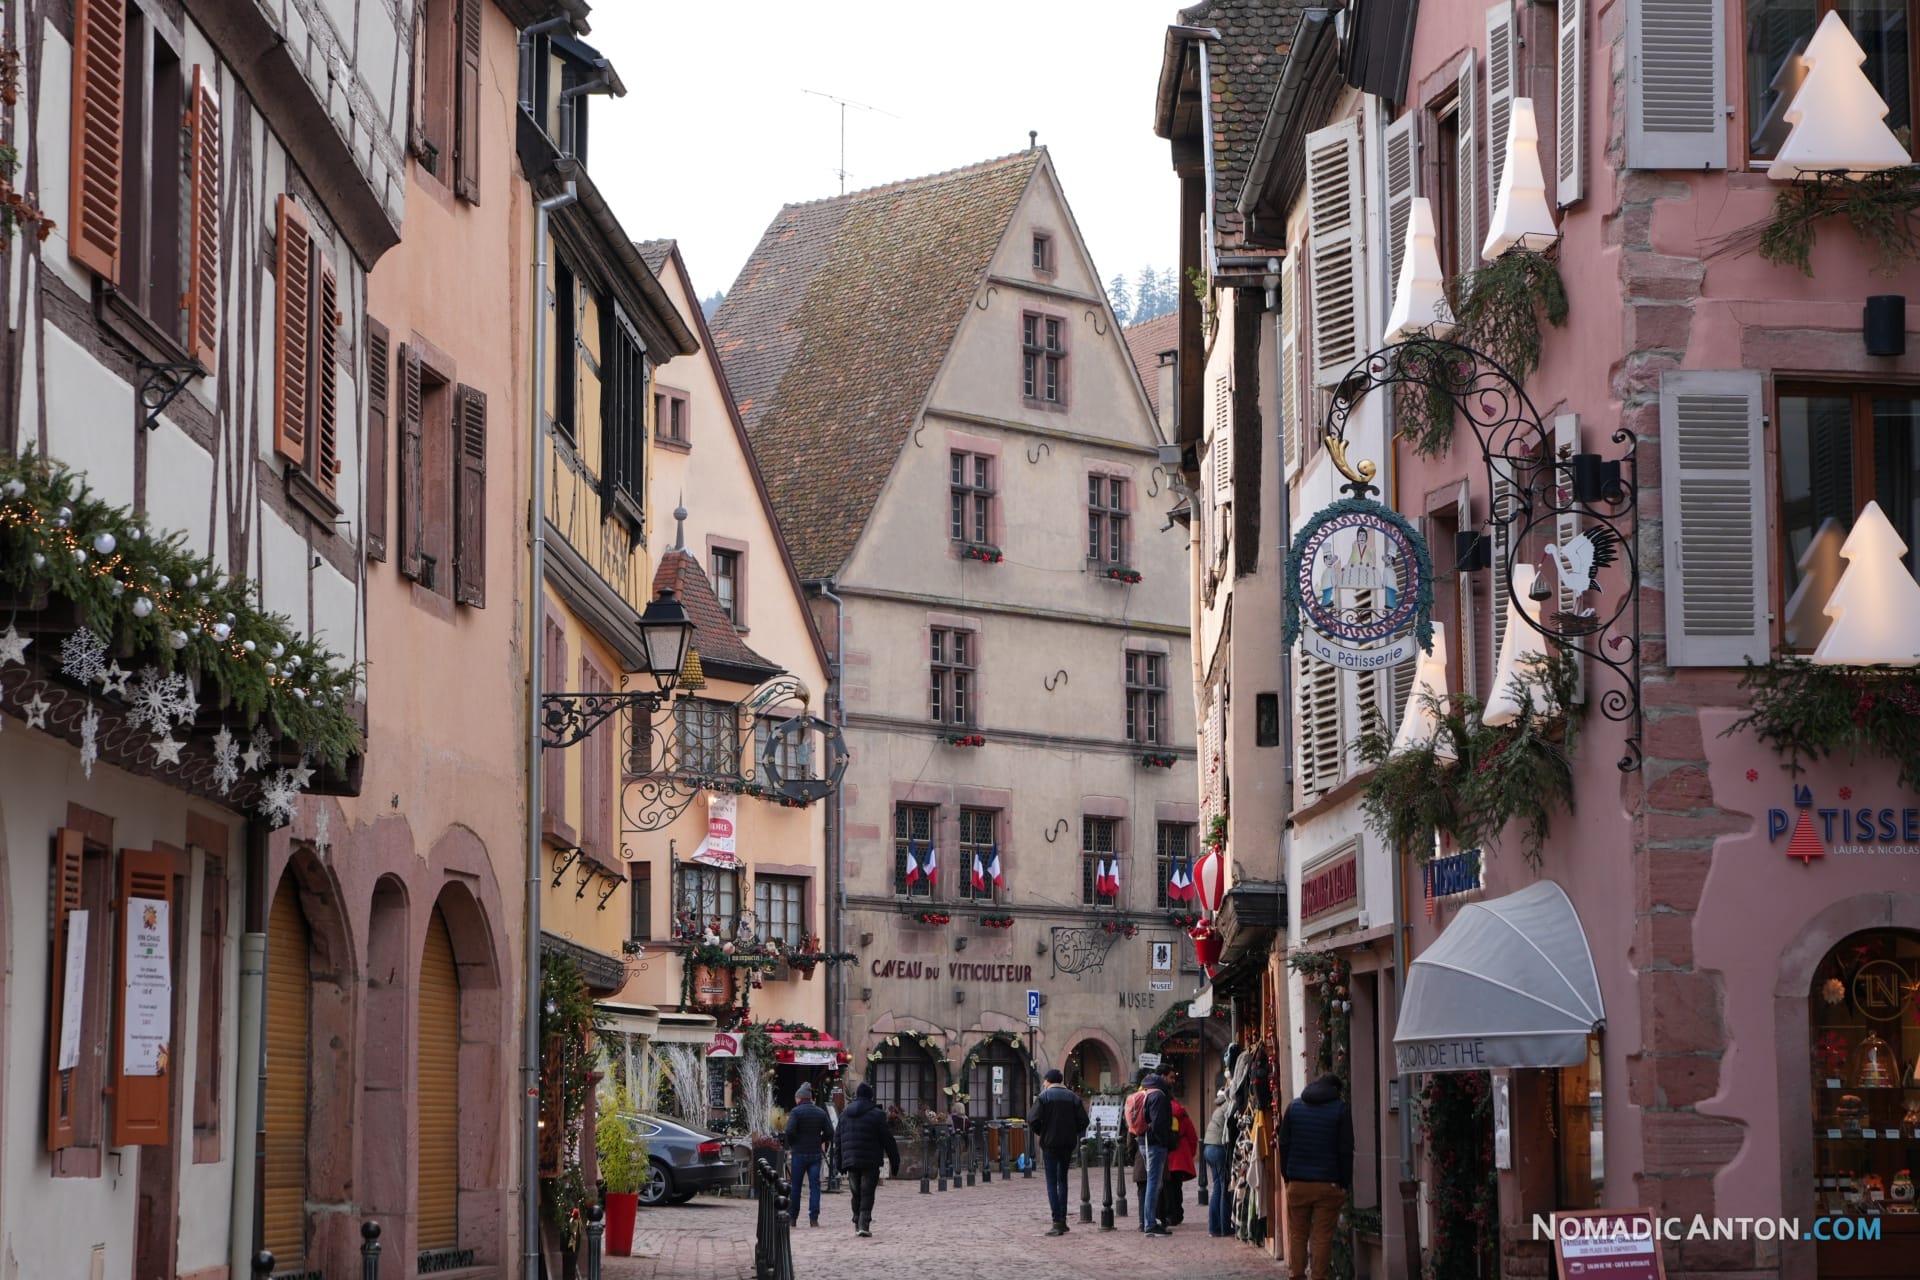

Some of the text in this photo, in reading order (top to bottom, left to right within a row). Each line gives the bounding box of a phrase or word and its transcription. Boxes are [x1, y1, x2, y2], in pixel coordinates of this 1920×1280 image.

[1315, 639, 1403, 667] La Pâtisserie
[1833, 846, 1920, 855] LAURA & NICOLAS
[871, 959, 1032, 982] CAVEAU DU VITICULTEUR
[1030, 995, 1037, 1012] P
[1398, 1044, 1426, 1068] ALON
[1428, 1043, 1447, 1065] DE
